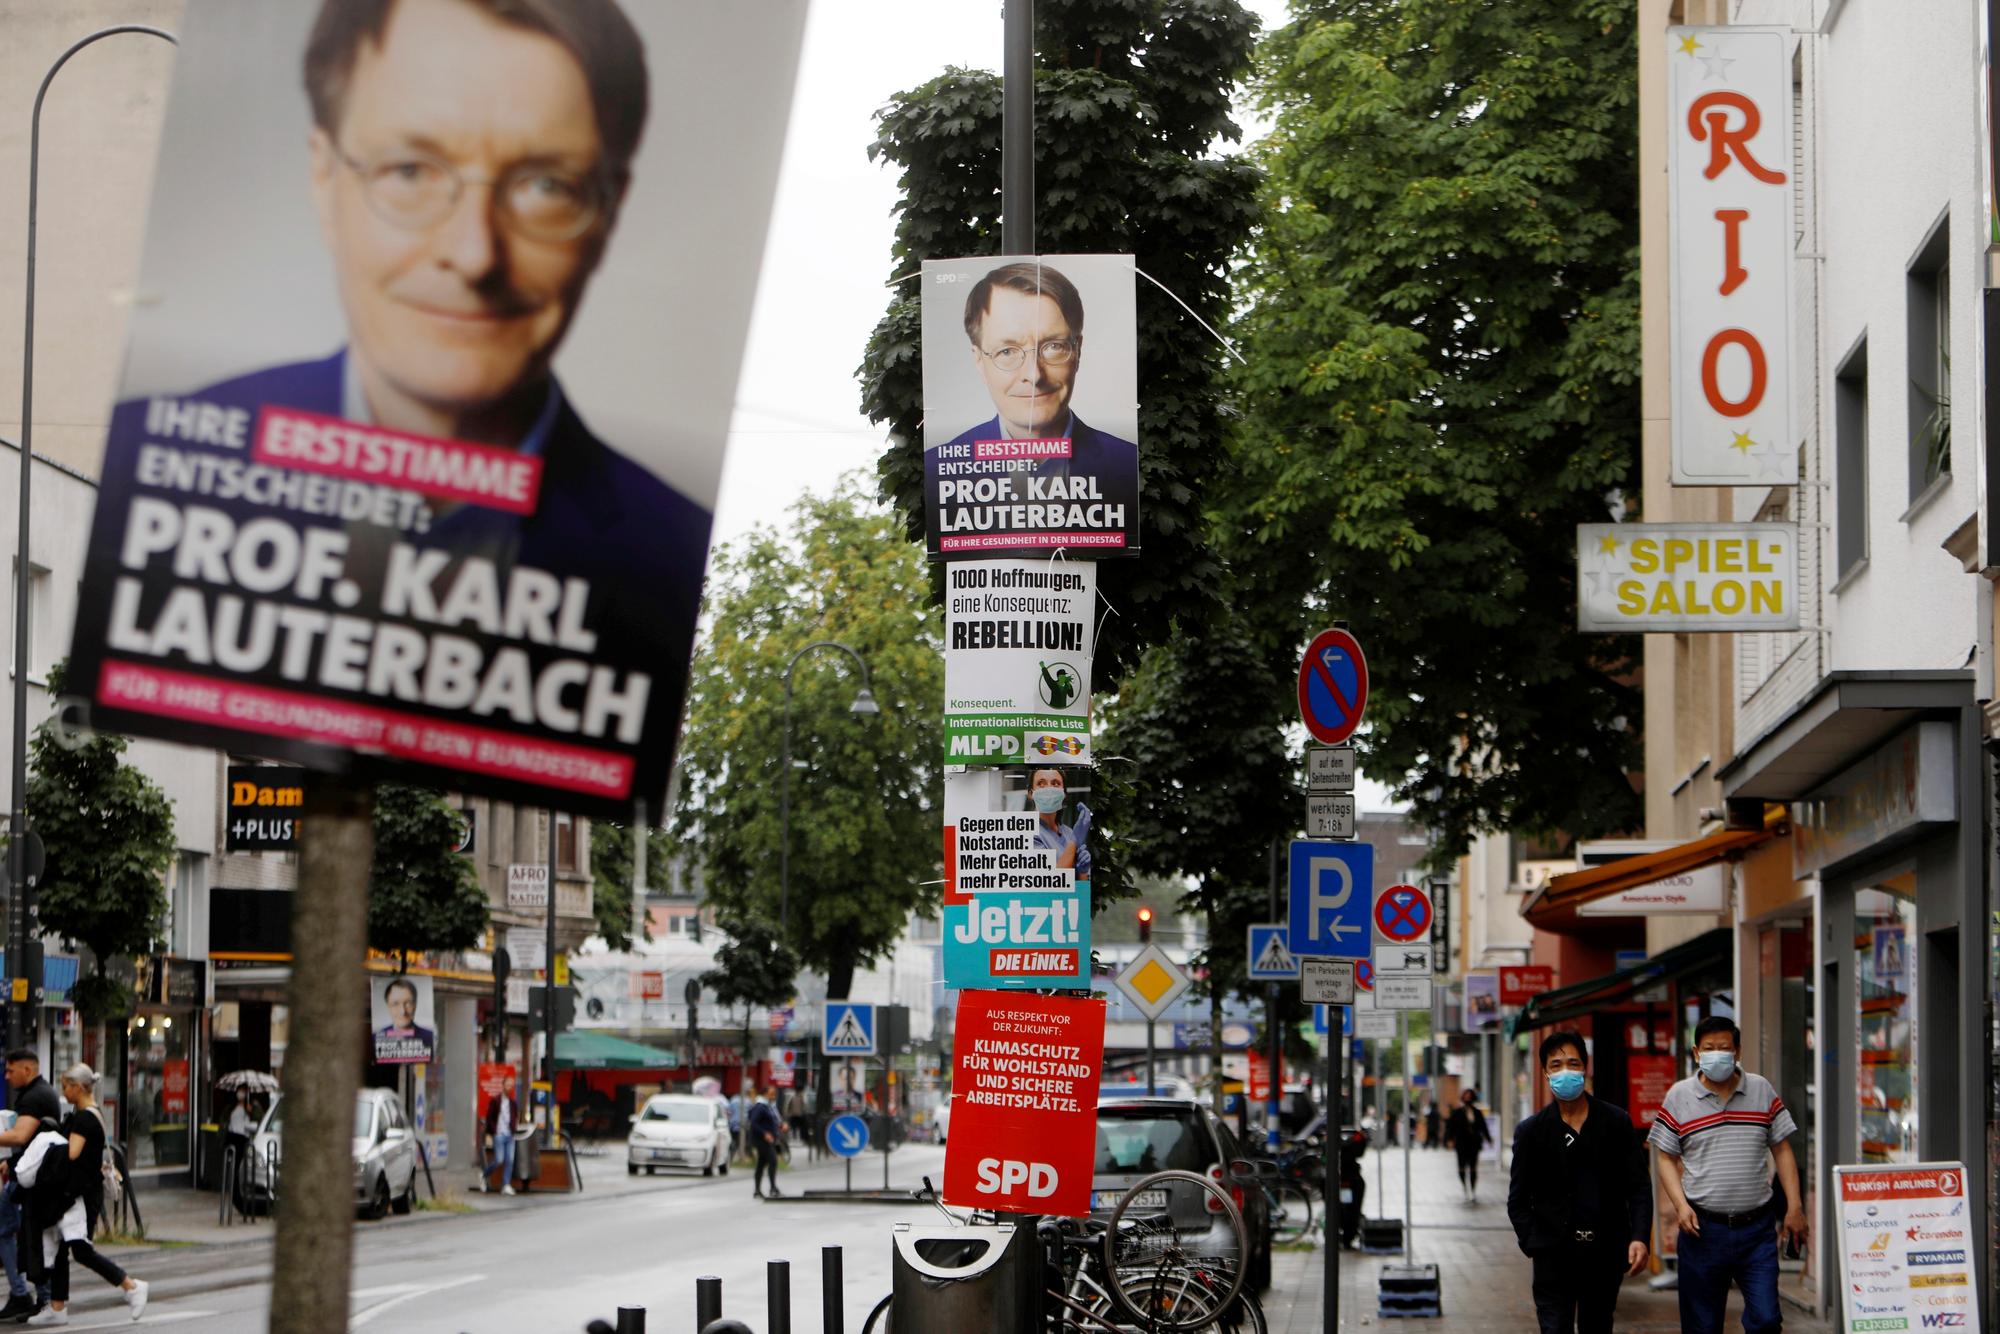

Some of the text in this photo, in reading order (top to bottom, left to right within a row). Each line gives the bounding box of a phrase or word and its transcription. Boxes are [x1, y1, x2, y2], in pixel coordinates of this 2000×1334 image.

[1687, 90, 1788, 419] RIO
[145, 398, 535, 504] IHRE ERSTSTIMME
[938, 441, 1069, 459] IHRE ERSTSTIMME
[938, 459, 1038, 476] ENTSCHEIDET:
[136, 444, 434, 535] ENTSCHEIDET:
[938, 476, 1103, 505] PROF. KARL
[939, 504, 1126, 532] LAUTERBACH
[943, 535, 1122, 548] FÜR IHRE GESUNDHEIT IN DEN BUNDESTAG
[1628, 538, 1783, 574] SPIEL-
[121, 497, 599, 655] PROF. KARL
[952, 568, 1086, 593] 1000 Hoffnungen,
[953, 594, 1071, 615] eine Konsequenz:
[1617, 579, 1784, 617] SALON
[952, 620, 1084, 651] REBELLION!
[107, 576, 653, 746] LAUTERBACH
[950, 699, 1016, 711] Konsequent.
[105, 671, 624, 789] FÜR IHRE GESUNDHEIT IN DEN BUNDESTAG
[950, 717, 1084, 729] Internationalistische Liste
[950, 735, 1020, 756] MLPD
[1311, 803, 1351, 817] werktags
[960, 816, 1035, 834] Gegen den
[1319, 819, 1342, 832] 7-18h
[960, 835, 1029, 851] Notstand:
[960, 854, 1052, 872] Mehr Gehalt,
[511, 868, 546, 882] AFRO
[960, 873, 1071, 889] mehr Personal.
[1652, 876, 1693, 888] TUDIO
[1309, 857, 1353, 941] P
[955, 899, 1080, 944] Jetzt!
[995, 952, 1075, 971] DIE LINKE.
[987, 1009, 1071, 1025] AUS RESPEKT VOR
[993, 1022, 1062, 1037] DER ZUKUNFT:
[974, 1039, 1081, 1061] KLIMASCHUTZ
[962, 1055, 1091, 1079] FÜR WOHLSTAND
[976, 1074, 1073, 1095] UND SICHERE
[966, 1090, 1082, 1113] ARBEITSPLÄTZE.
[975, 1157, 1059, 1198] SPD
[1847, 1179, 1937, 1192] TURKISH AIRLINES
[1847, 1219, 1898, 1229] SunExpress
[1919, 1230, 1963, 1239] corendon
[1915, 1253, 1965, 1264] RYANAIR
[1851, 1270, 1891, 1278] Eurowings
[1855, 1320, 1905, 1331] FLIXBUS
